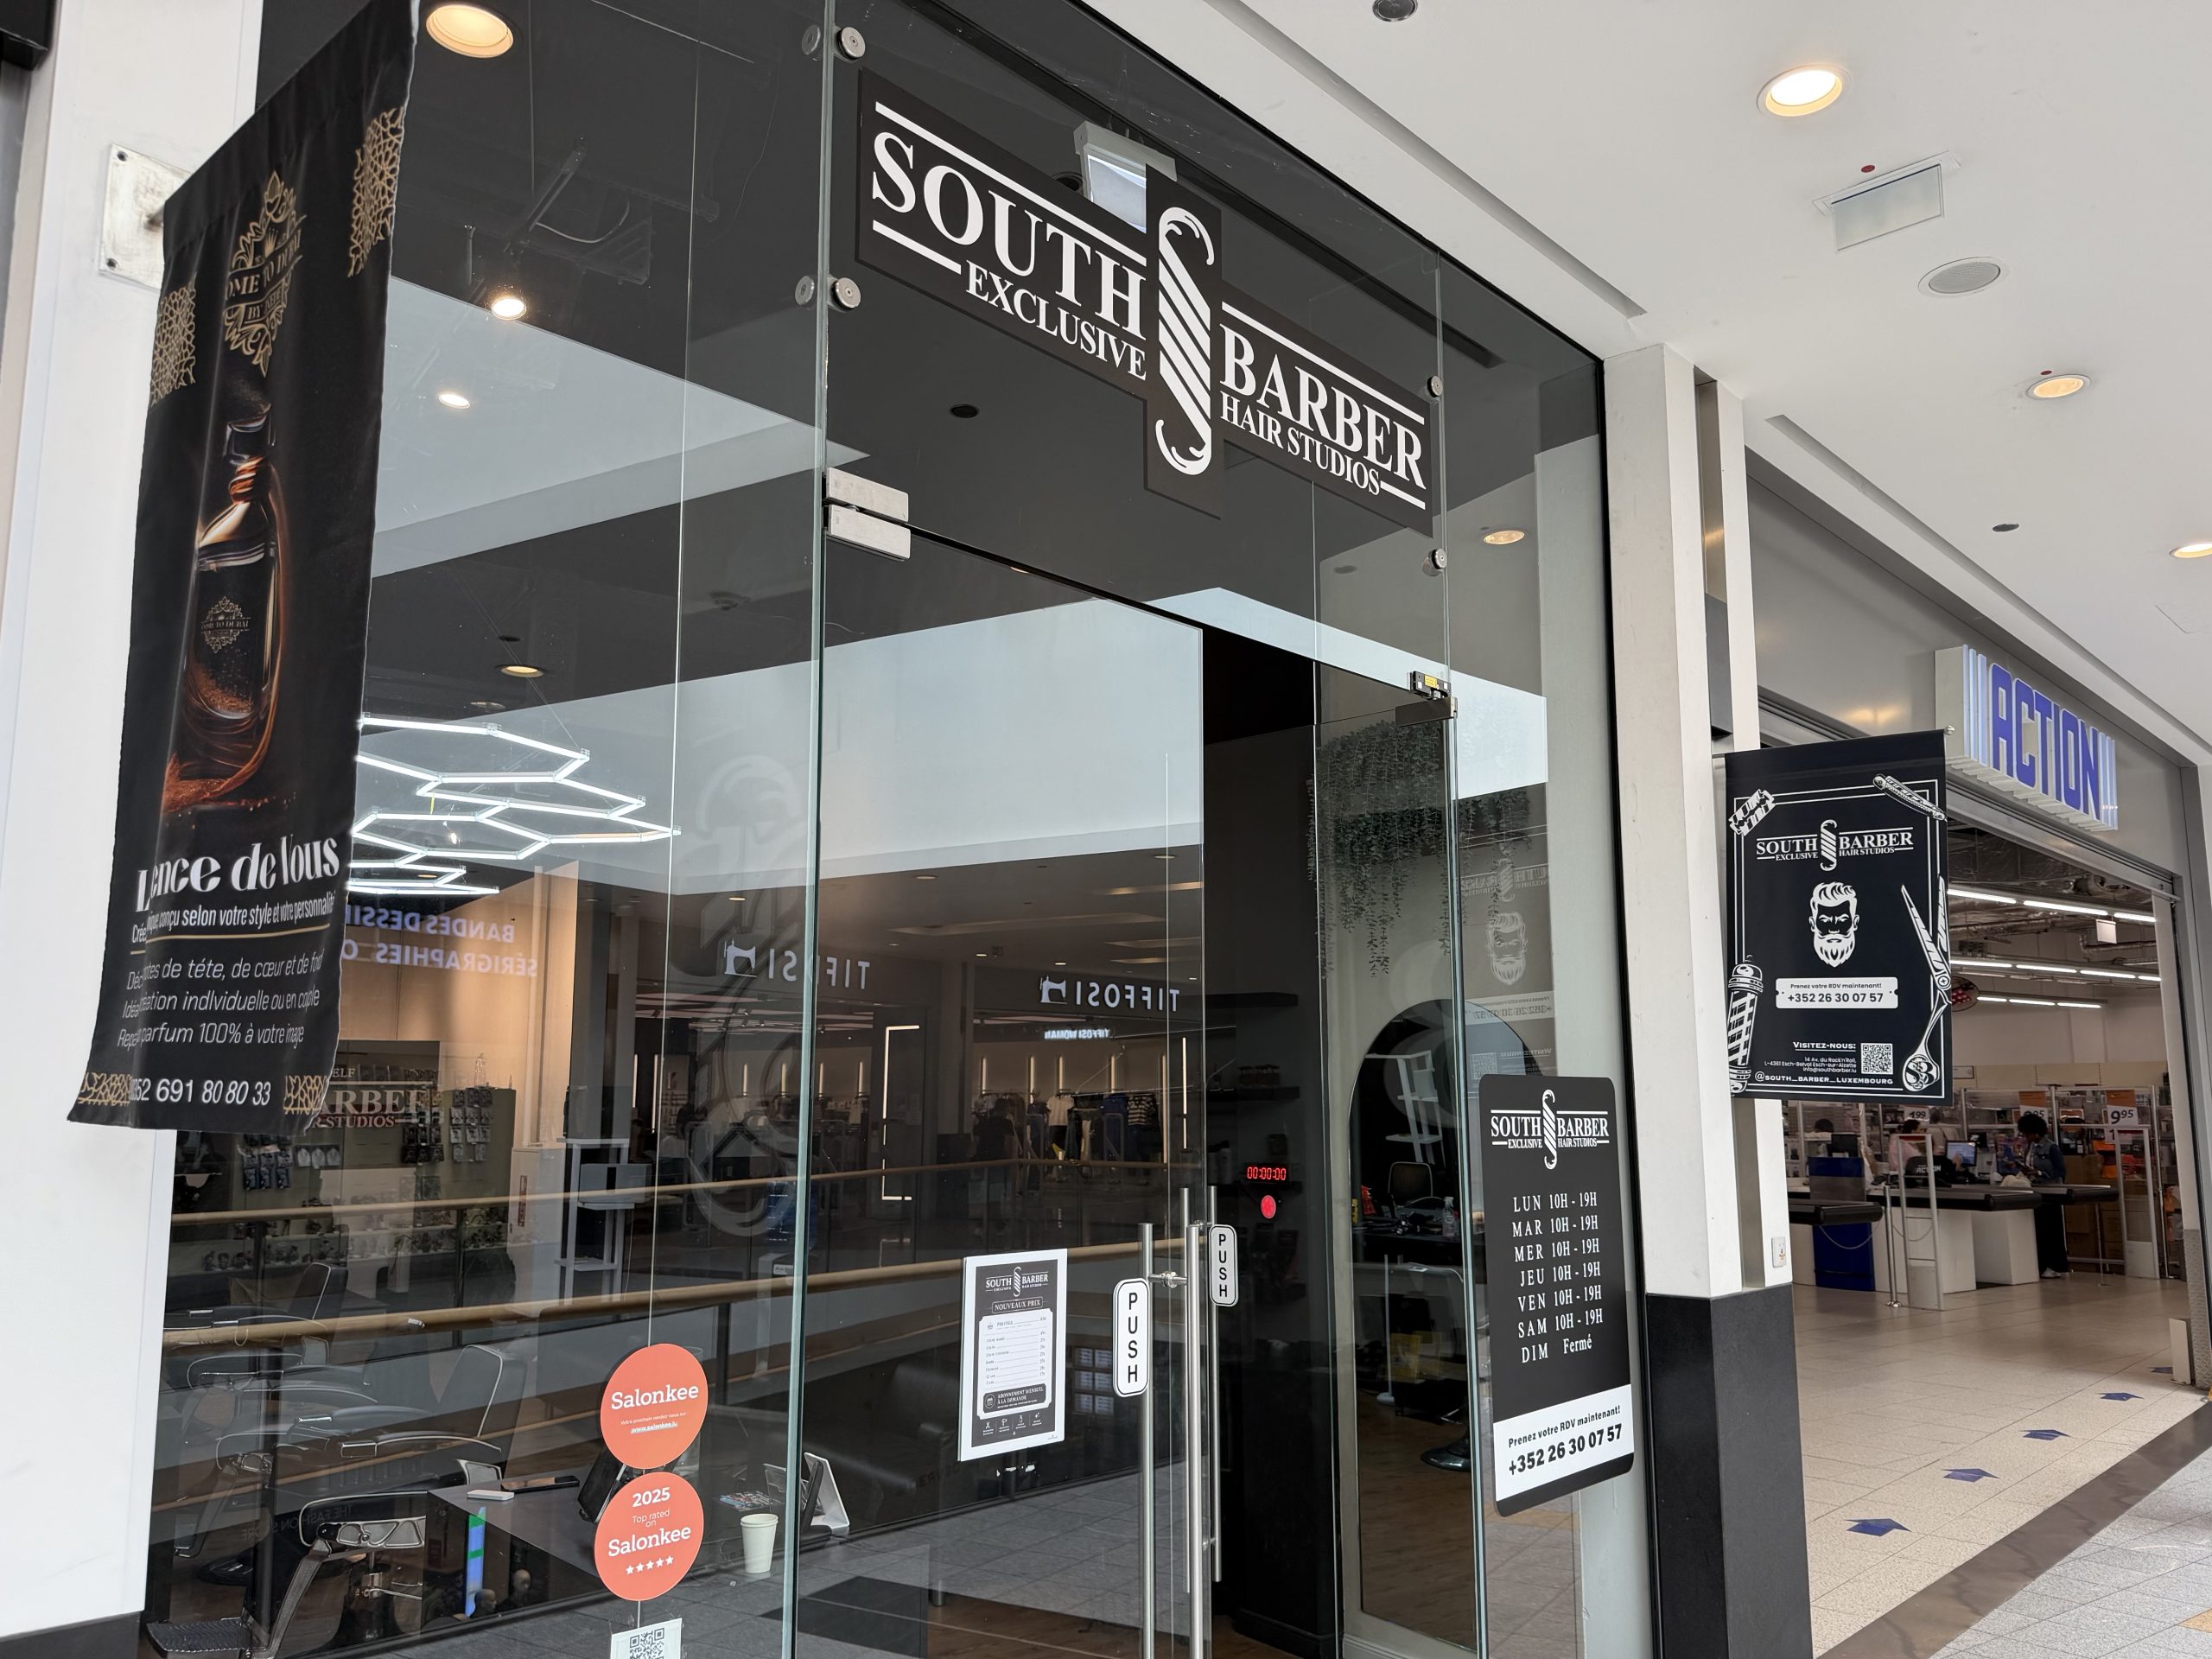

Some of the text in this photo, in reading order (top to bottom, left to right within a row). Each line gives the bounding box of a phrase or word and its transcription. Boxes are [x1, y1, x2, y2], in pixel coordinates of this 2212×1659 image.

[872, 131, 1427, 489] SOUTH BARBER
[966, 260, 1381, 495] EXCLUSIVE HAIR STUDIOS
[1990, 663, 2101, 821] ACTION
[1757, 832, 1913, 855] SOUTH BARBER
[1775, 852, 1818, 861] EXCLUSIVE
[1859, 847, 1895, 855] STUDIOS
[232, 842, 276, 891] de
[181, 905, 216, 926] selon
[220, 906, 247, 926] votre
[249, 901, 272, 929] style
[272, 901, 280, 923] et
[162, 957, 181, 978] de
[232, 957, 251, 978] de
[254, 960, 283, 976] cœur
[285, 958, 296, 976] et
[296, 955, 308, 974] de
[270, 995, 284, 1010] ou
[285, 993, 296, 1009] en
[1788, 993, 1884, 1002] +352 26 30 07 57
[140, 1022, 194, 1048] parfum
[200, 1023, 241, 1044] 100%
[245, 1022, 253, 1044] à
[258, 1024, 285, 1044] votre
[156, 1078, 194, 1103] 691
[201, 1080, 224, 1104] 80
[225, 1080, 249, 1104] 80
[252, 1081, 271, 1106] 33
[326, 1116, 394, 1128] STUDIOS
[1491, 1116, 1609, 1137] SOUTH BARBER
[1508, 1137, 1598, 1149] EXCLUSIVE HAIR STUDIOS
[1247, 1166, 1287, 1181] 00:00:00
[1916, 1165, 1942, 1173] ACTON
[1513, 1195, 1541, 1212] LUN
[1549, 1193, 1568, 1210] 10H
[1580, 1192, 1598, 1207] 19H
[1512, 1219, 1542, 1237] MAR
[1550, 1217, 1569, 1233] 10H
[1580, 1215, 1599, 1230] 19H
[1515, 1243, 1544, 1262] MER
[1552, 1241, 1570, 1257] 10H
[1581, 1238, 1599, 1254] 19H
[1217, 1233, 1228, 1298] PUSH
[1520, 1268, 1545, 1287] JEU
[1553, 1265, 1572, 1282] 10H
[1582, 1262, 1601, 1278] 19H
[986, 1277, 1012, 1288] SOUTH
[1022, 1274, 1049, 1285] BARBER
[995, 1301, 1027, 1311] NOUVEAUX
[1518, 1293, 1546, 1312] VEN
[1554, 1288, 1573, 1306] 10H
[1584, 1285, 1602, 1302] 19H
[1518, 1318, 1548, 1338] SAM
[1555, 1313, 1573, 1332] 10H
[1585, 1308, 1604, 1325] 19H
[1128, 1292, 1138, 1383] PUSH
[1521, 1333, 1592, 1363] DIM Fermé
[611, 1384, 699, 1410] Salonkee
[1508, 1405, 1621, 1448] Prenez votre RDV maintenant!
[1509, 1423, 1623, 1476] +352 26 30 07 57
[632, 1486, 671, 1508] 2025
[632, 1508, 671, 1525] Top rated
[645, 1518, 657, 1528] on
[607, 1526, 691, 1557] Salonkee
